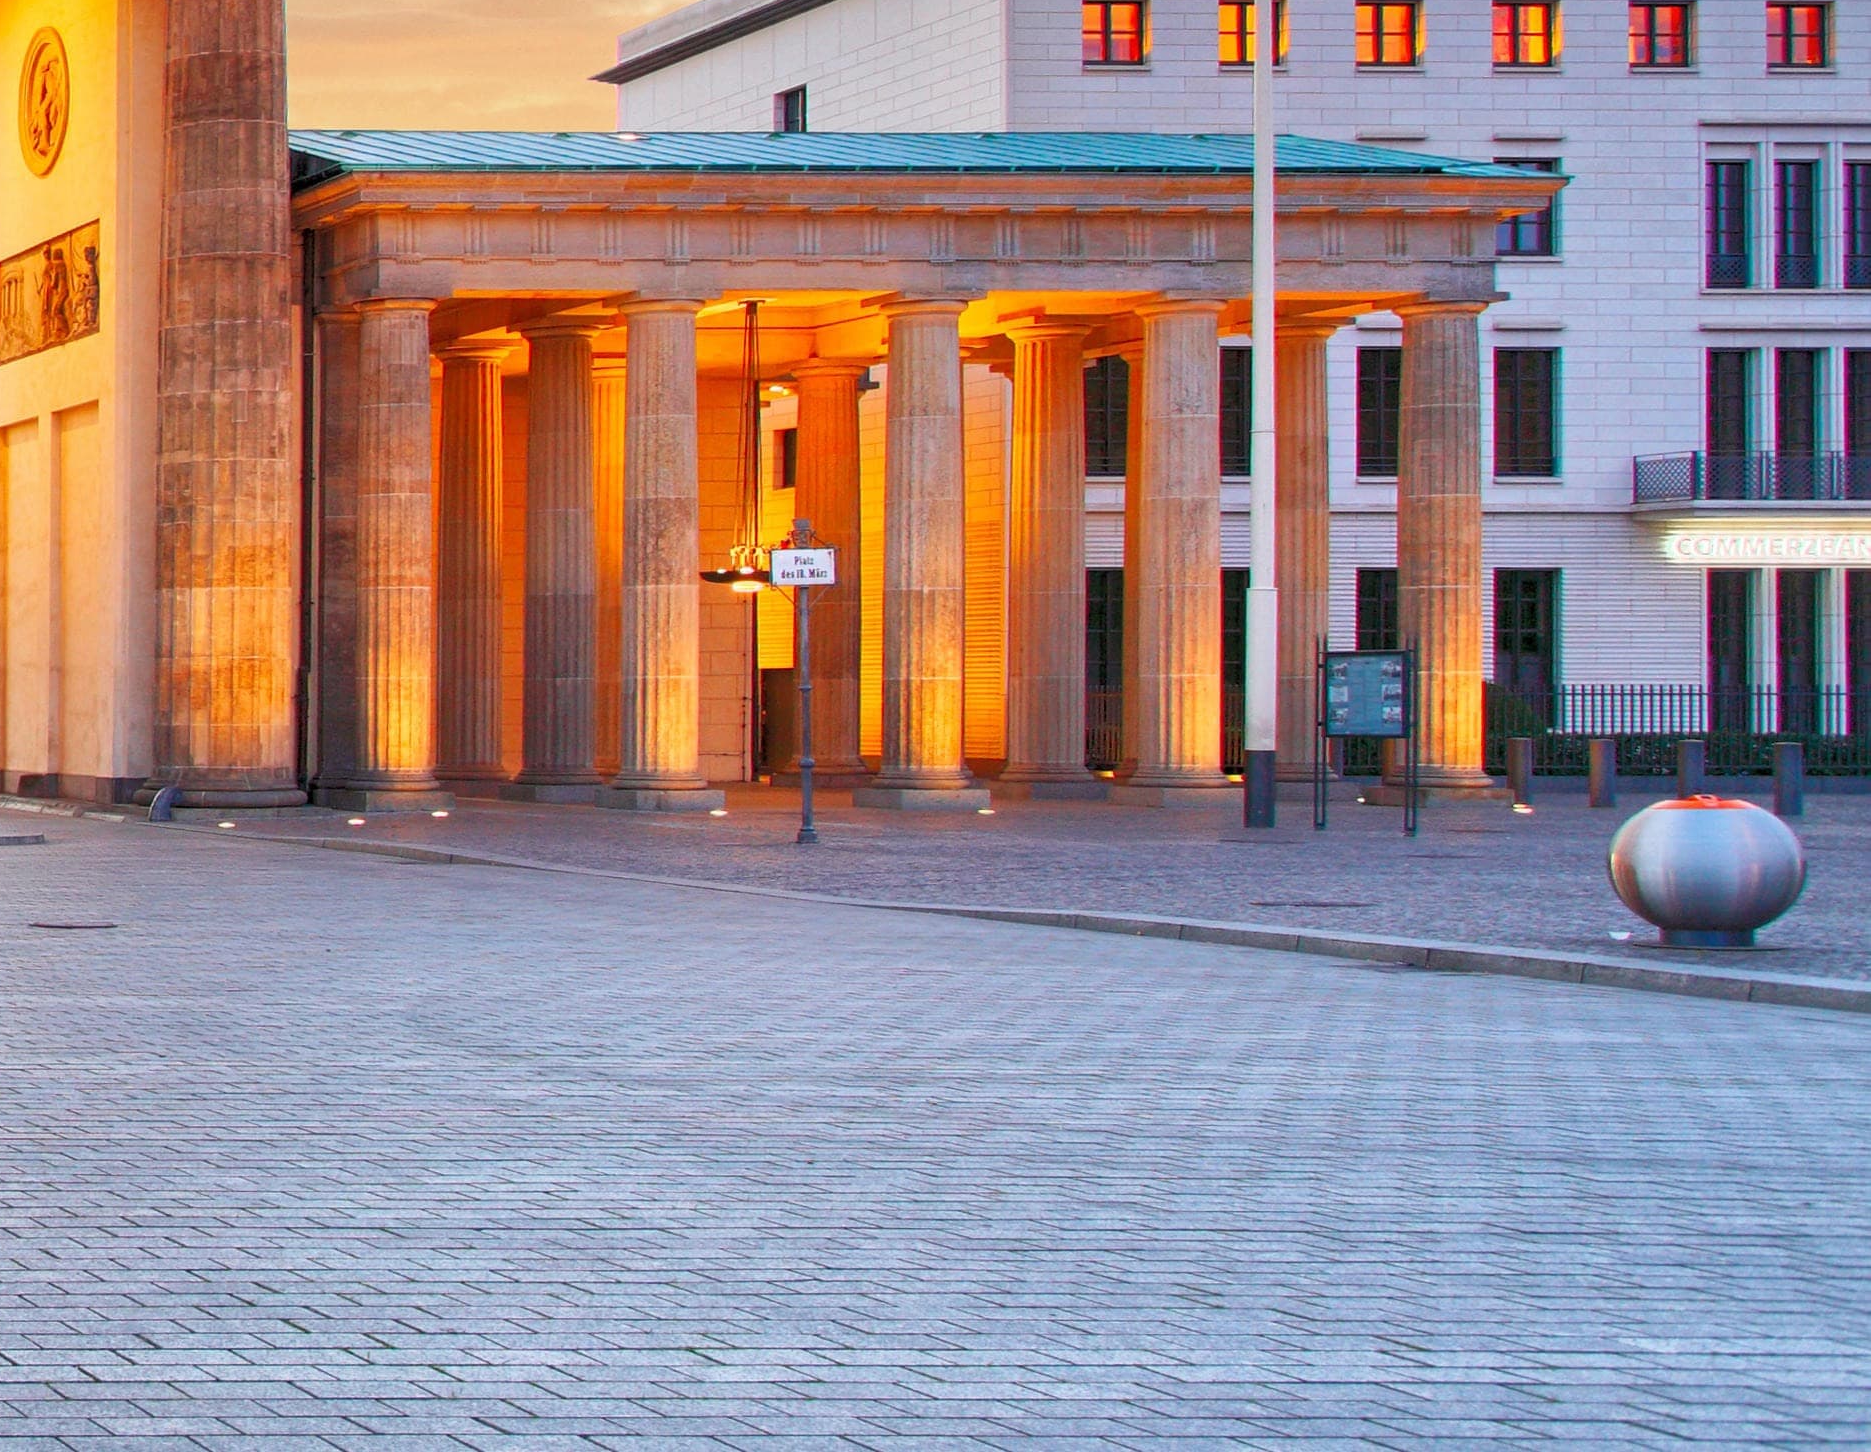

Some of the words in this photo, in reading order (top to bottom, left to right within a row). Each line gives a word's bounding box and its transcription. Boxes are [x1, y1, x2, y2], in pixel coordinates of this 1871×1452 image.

[794, 556, 814, 565] Platz
[781, 570, 795, 579] des
[808, 568, 828, 579] März
